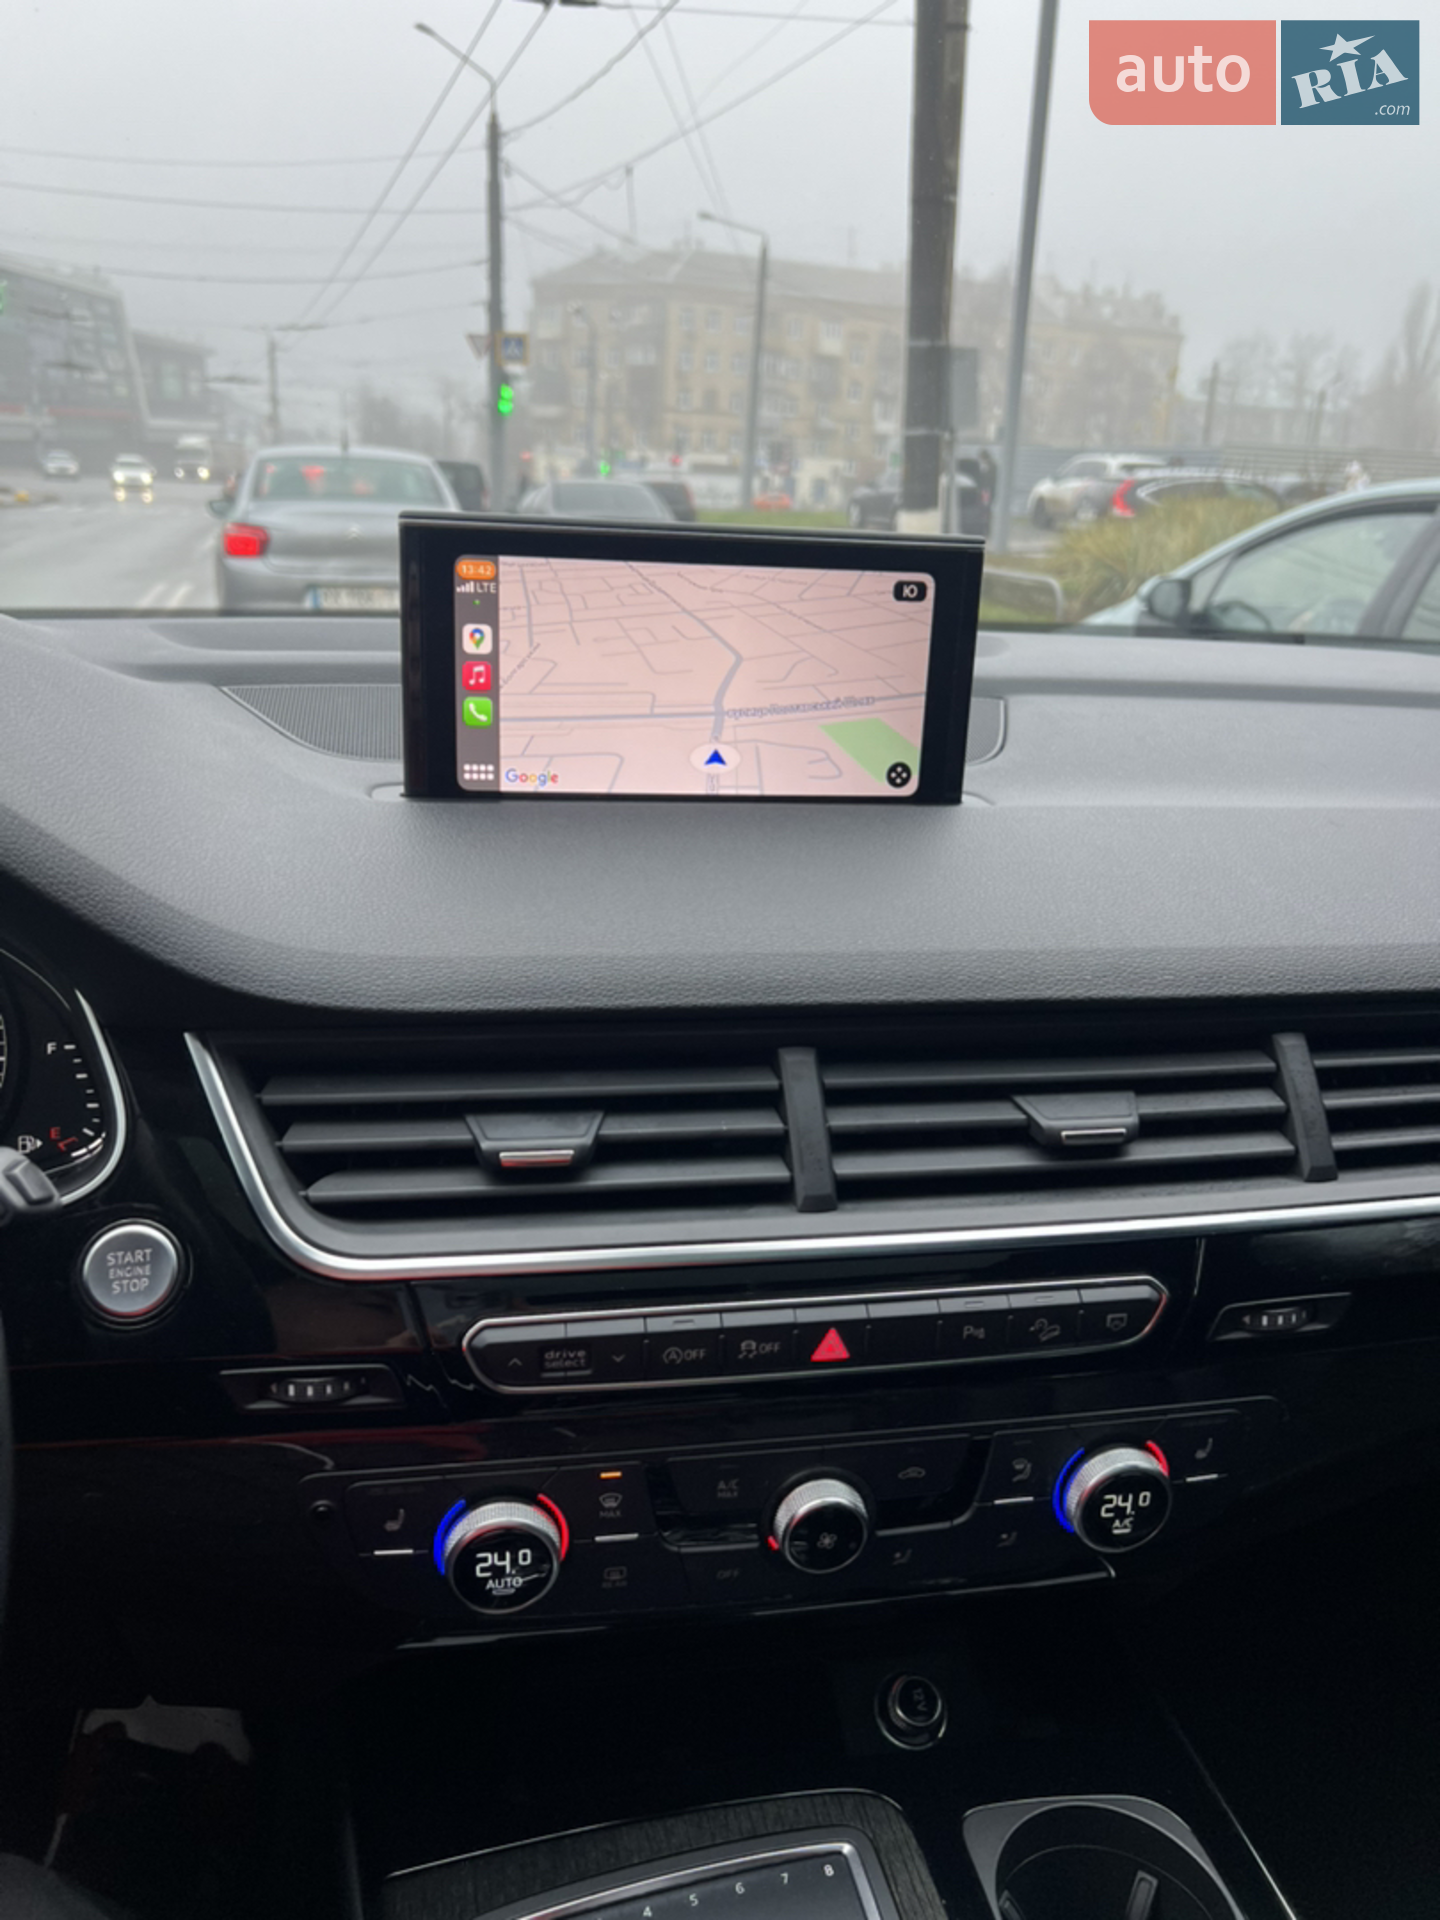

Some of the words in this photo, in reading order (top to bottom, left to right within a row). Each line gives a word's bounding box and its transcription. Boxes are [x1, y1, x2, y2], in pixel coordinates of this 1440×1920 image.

[461, 563, 492, 576] 13:42
[475, 582, 497, 594] LTE
[504, 768, 559, 787] Google
[46, 1042, 57, 1055] F
[49, 1127, 61, 1140] E
[106, 1248, 153, 1267] START
[108, 1264, 152, 1279] ENGINE
[112, 1277, 149, 1295] STOP
[544, 1347, 587, 1361] drive
[684, 1348, 707, 1361] OFF
[758, 1342, 781, 1354] OFF
[544, 1357, 587, 1369] select
[1100, 1491, 1152, 1519] 24.0
[1112, 1517, 1134, 1529] A/C
[475, 1548, 532, 1578] 24.0
[485, 1576, 523, 1590] AUTO
[642, 1905, 653, 1918] 4
[688, 1893, 699, 1906] 5
[735, 1881, 745, 1894] 6
[780, 1872, 790, 1885] 7
[824, 1863, 835, 1876] 8
